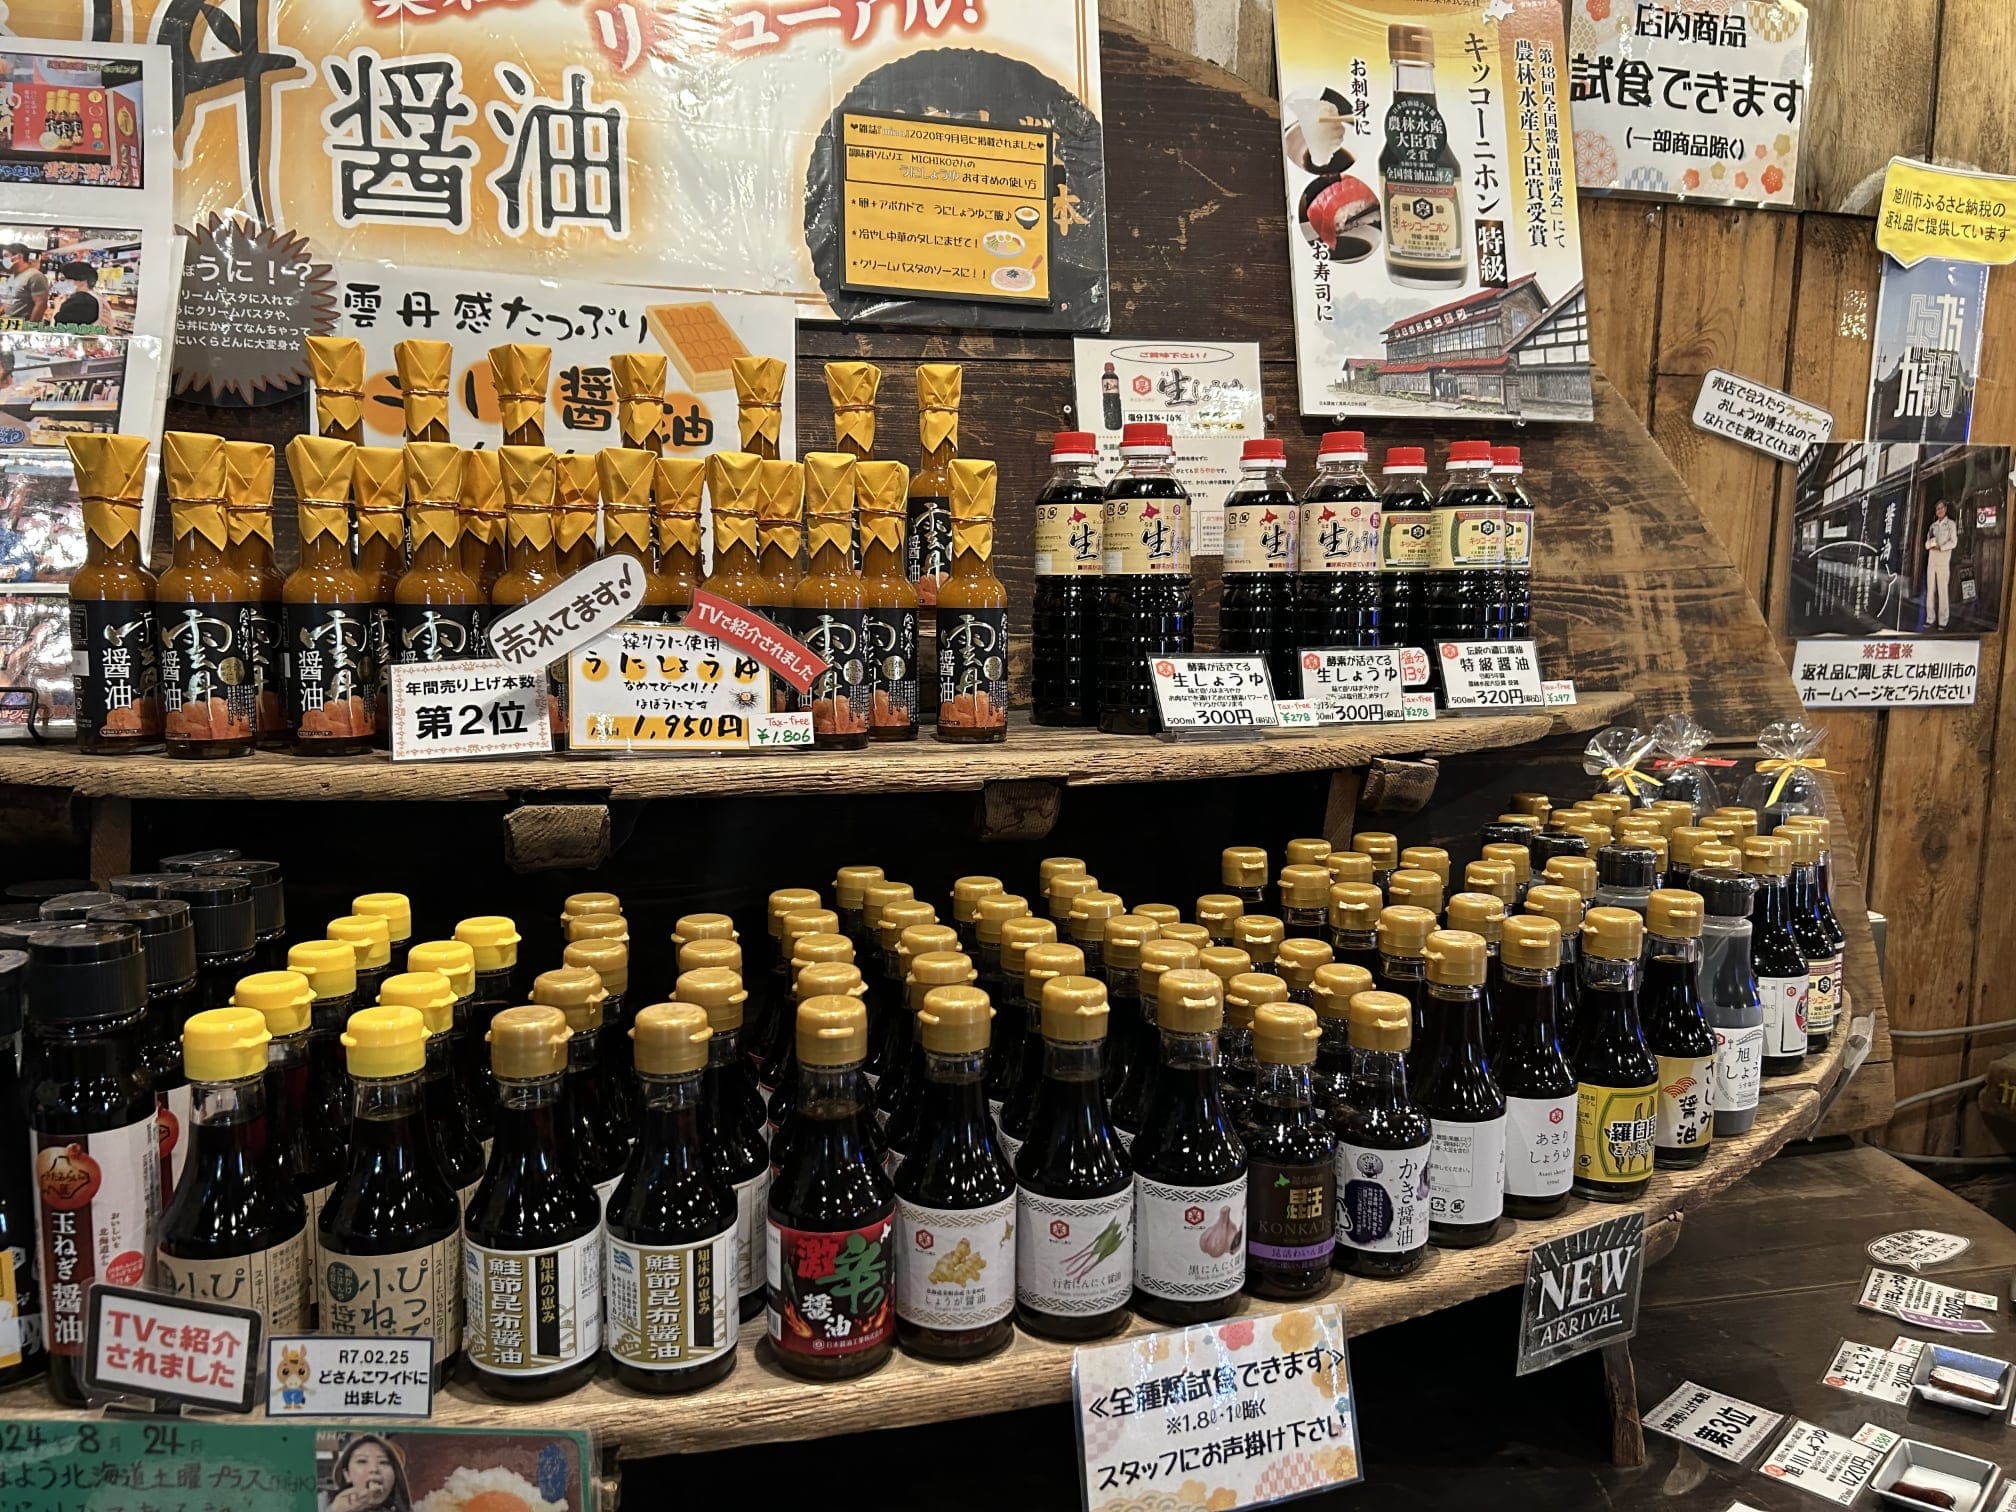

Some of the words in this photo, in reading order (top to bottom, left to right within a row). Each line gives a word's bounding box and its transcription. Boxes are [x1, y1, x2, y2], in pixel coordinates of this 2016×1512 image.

[1634, 3, 1747, 48] 店内商品
[1350, 58, 1371, 136] お刺身に
[1569, 52, 1804, 123] 試食できます
[1388, 116, 1444, 135] 農林水産
[1463, 32, 1501, 216] キッコーニホン
[329, 55, 622, 240] 醤油
[1395, 132, 1438, 150] 大臣賞
[1406, 150, 1429, 162] 受賞
[1515, 39, 1548, 248] 農林水産大臣賞受賞
[1625, 126, 1745, 161] （一部商品除く）
[911, 154, 976, 169] MICHIKOさんの
[962, 173, 1037, 190] おすすめの使い方
[1892, 186, 2006, 218] 旭川市ふるさと納税の
[1400, 219, 1449, 233] キッコーニホン
[1884, 210, 2011, 243] 返礼品に提供しています
[1477, 226, 1507, 284] 特級
[1311, 241, 1333, 322] お寿司に
[344, 282, 648, 344] 雲丹感たっぷり
[1703, 411, 1802, 457] なんでも教えてくれま
[1717, 398, 1817, 443] おしょうゆ博士なので
[1319, 522, 1379, 560] 生しょうゆ
[494, 562, 634, 665] 売れてます！
[622, 631, 720, 652] 練りうに使用
[697, 601, 815, 683] TVで紹介されました
[1401, 650, 1425, 664] 塩分
[585, 650, 760, 680] うにしょうゆ
[939, 649, 956, 704] 醤油
[1187, 662, 1251, 672] 酵素が活きてる
[1317, 667, 1398, 683] 生しょうゆ
[1326, 655, 1392, 667] 酵素が活きてる
[1403, 665, 1426, 682] 13%
[1460, 656, 1530, 672] 特級醤油
[1801, 662, 1976, 682] 返礼品に関しましては旭川市の
[102, 646, 133, 712] 醤油
[161, 649, 183, 713] 醤油
[298, 649, 325, 713] 醤油
[405, 674, 536, 697] 年間売り上げ本数
[624, 680, 719, 694] なめてびっくり！！
[1172, 672, 1264, 688] 生しょうゆ
[1802, 685, 1971, 702] ホームページをごらんください
[635, 699, 708, 711] ほぼうにです
[1277, 702, 1311, 710] Tax-free
[1334, 704, 1384, 721] 300円
[1405, 706, 1429, 717] ¥278
[1451, 696, 1476, 704] 500ml
[1476, 689, 1524, 705] 320円
[415, 700, 528, 740] 第2位
[633, 714, 743, 739] 1,950円
[765, 716, 810, 727] Tax-free
[1167, 717, 1196, 725] 500ml
[1196, 709, 1254, 725] 300円
[1280, 712, 1311, 722] ¥278
[1736, 1047, 1750, 1063] 旭
[1700, 1058, 1715, 1133] さしみ
[1676, 1094, 1698, 1145] 醤油
[1535, 1129, 1569, 1146] あさり
[1529, 1147, 1571, 1165] しょうゆ
[1397, 1158, 1418, 1246] かき醤油
[50, 1210, 84, 1345] 玉ねぎ醤油
[538, 1257, 556, 1324] 知床の恵み
[697, 1247, 711, 1316] 知床の恵み
[1536, 1245, 1636, 1320] NEW
[488, 1257, 524, 1365] 鮭節昆布醤油
[644, 1253, 681, 1361] 鮭節昆布醤油
[800, 1292, 852, 1339] 醤油
[107, 1309, 241, 1360] TVで紹介
[1540, 1303, 1620, 1347] ARRIVAL
[106, 1344, 236, 1389] されました
[338, 1350, 409, 1365] R7.02.25
[1840, 1345, 1874, 1384] 生しょうゆ
[318, 1369, 429, 1386] どさんこワイドに
[344, 1390, 402, 1407] 出ました
[0, 1424, 48, 1453] 24
[79, 1424, 100, 1452] 8
[143, 1425, 185, 1455] 24
[1693, 1406, 1758, 1449] 第3位
[1097, 1414, 1347, 1491] スタッフにお声掛け下さい
[1784, 1428, 1830, 1478] 旭川しょうゆ
[1838, 1455, 1876, 1488] 420円
